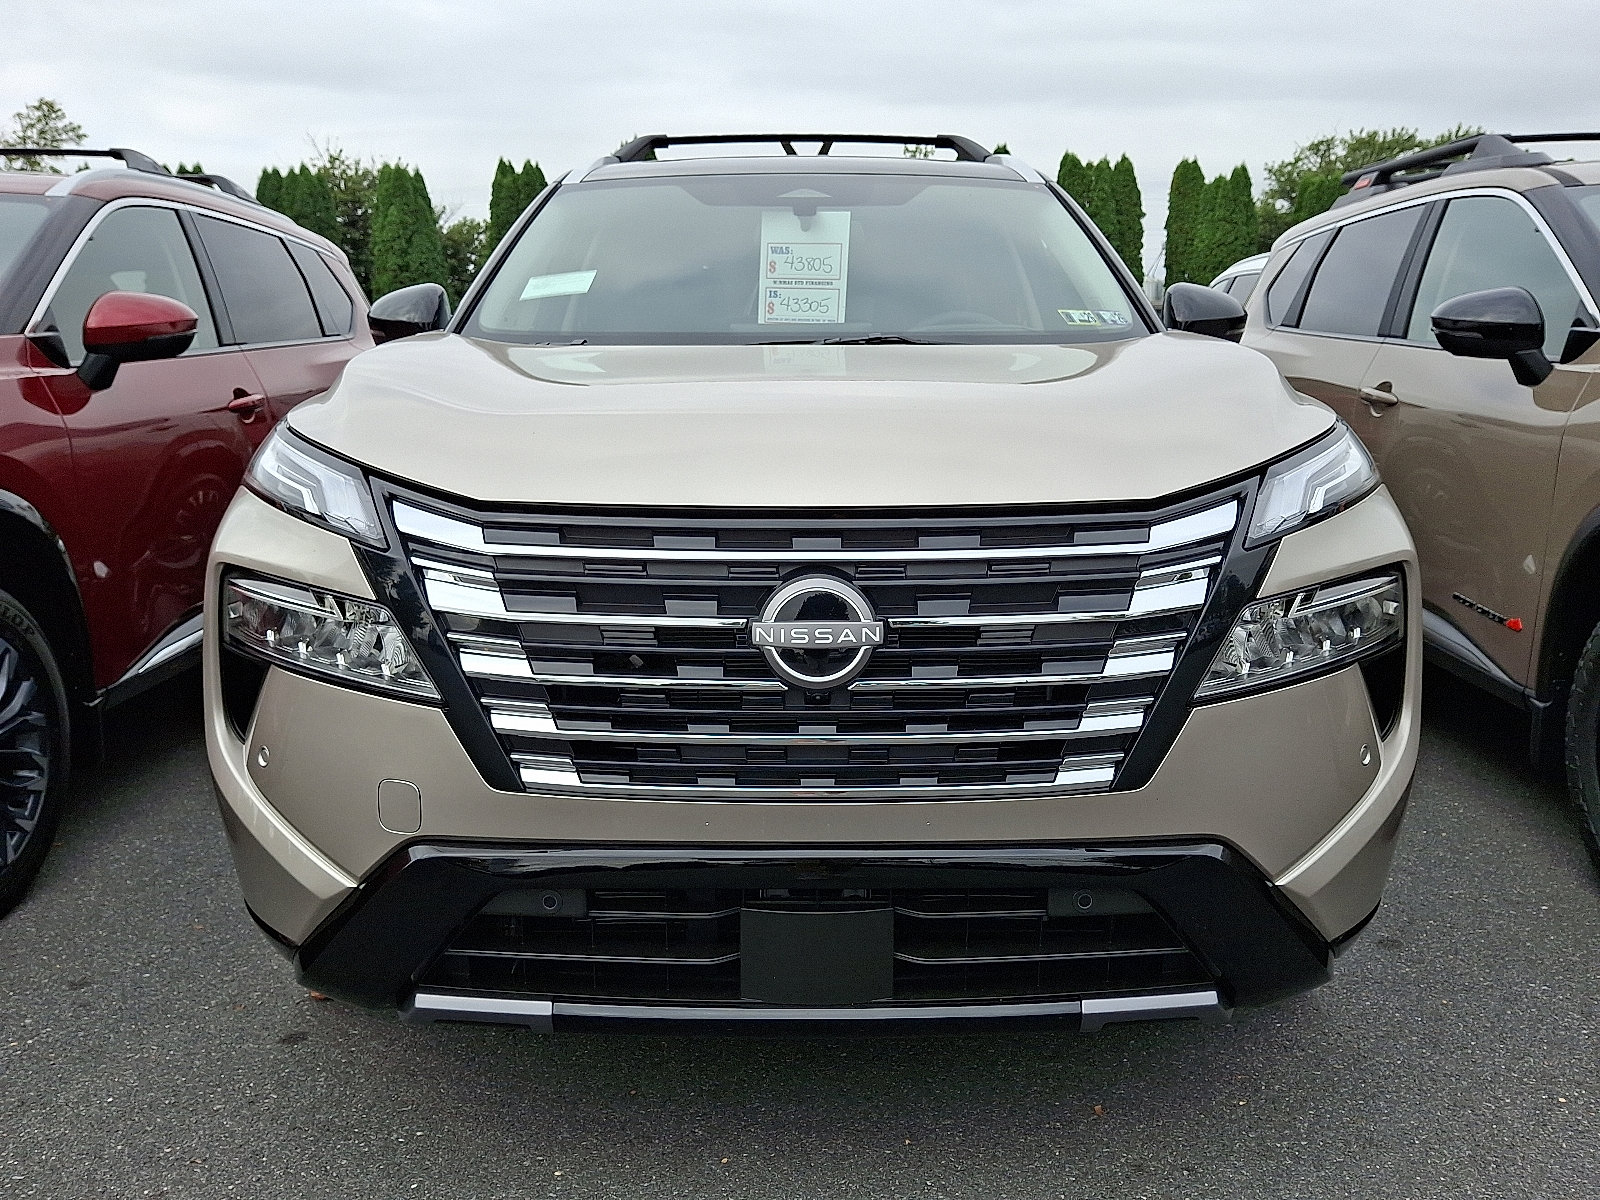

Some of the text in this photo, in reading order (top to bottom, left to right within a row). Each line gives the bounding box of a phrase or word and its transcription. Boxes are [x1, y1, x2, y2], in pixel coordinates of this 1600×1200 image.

[770, 246, 793, 255] WAS:
[783, 255, 833, 274] 43805
[768, 290, 782, 299] IS:
[780, 296, 832, 314] 43305
[755, 626, 880, 644] NISSAN
